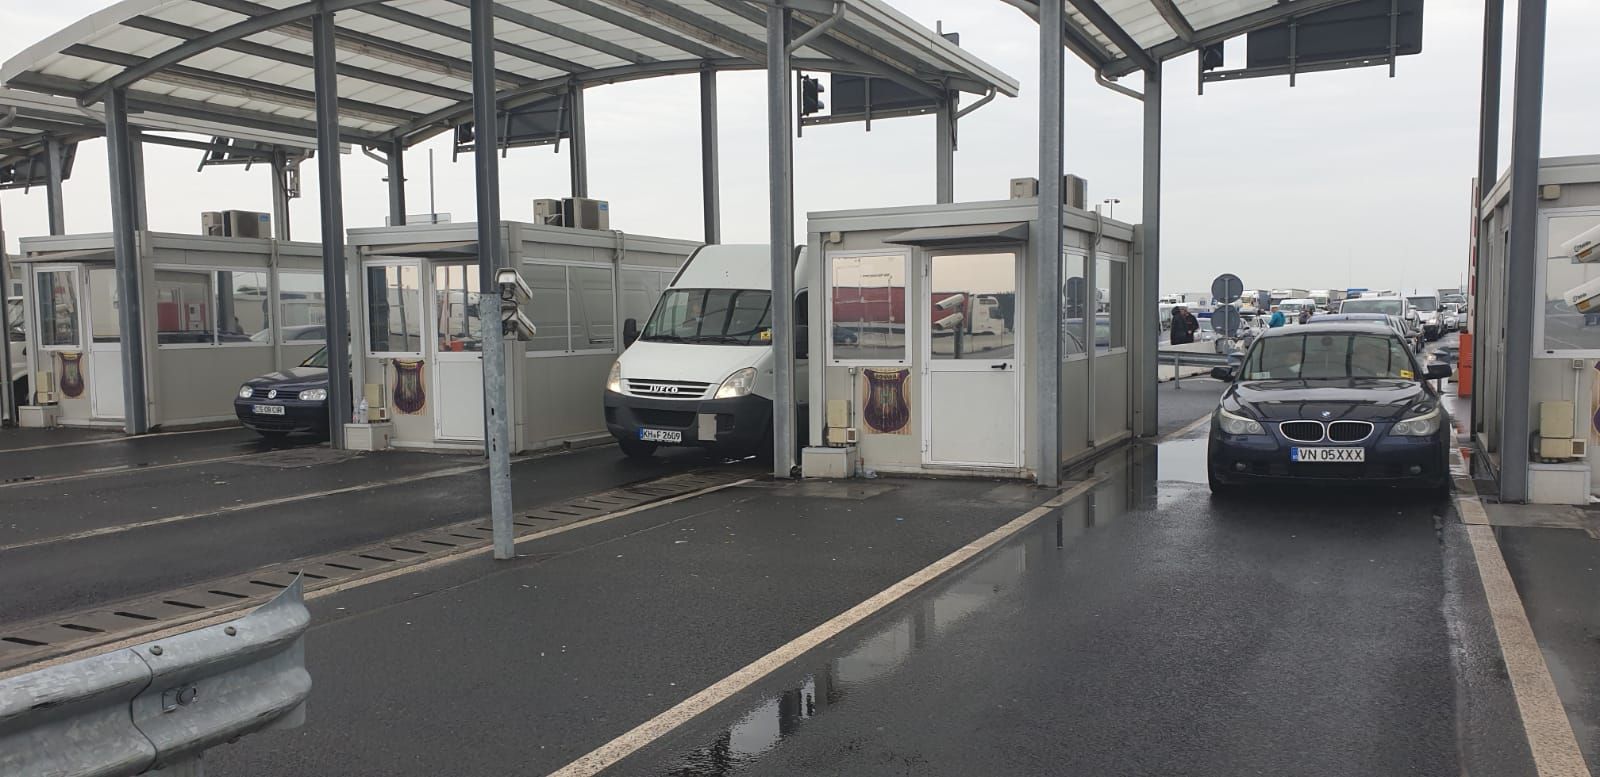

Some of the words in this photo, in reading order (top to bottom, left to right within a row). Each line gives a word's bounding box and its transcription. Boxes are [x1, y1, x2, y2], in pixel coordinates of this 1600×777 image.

[649, 384, 678, 393] IVECO
[643, 429, 652, 438] KH
[663, 431, 681, 440] 2609
[1299, 449, 1317, 460] VN
[1321, 449, 1362, 460] 05XXX
